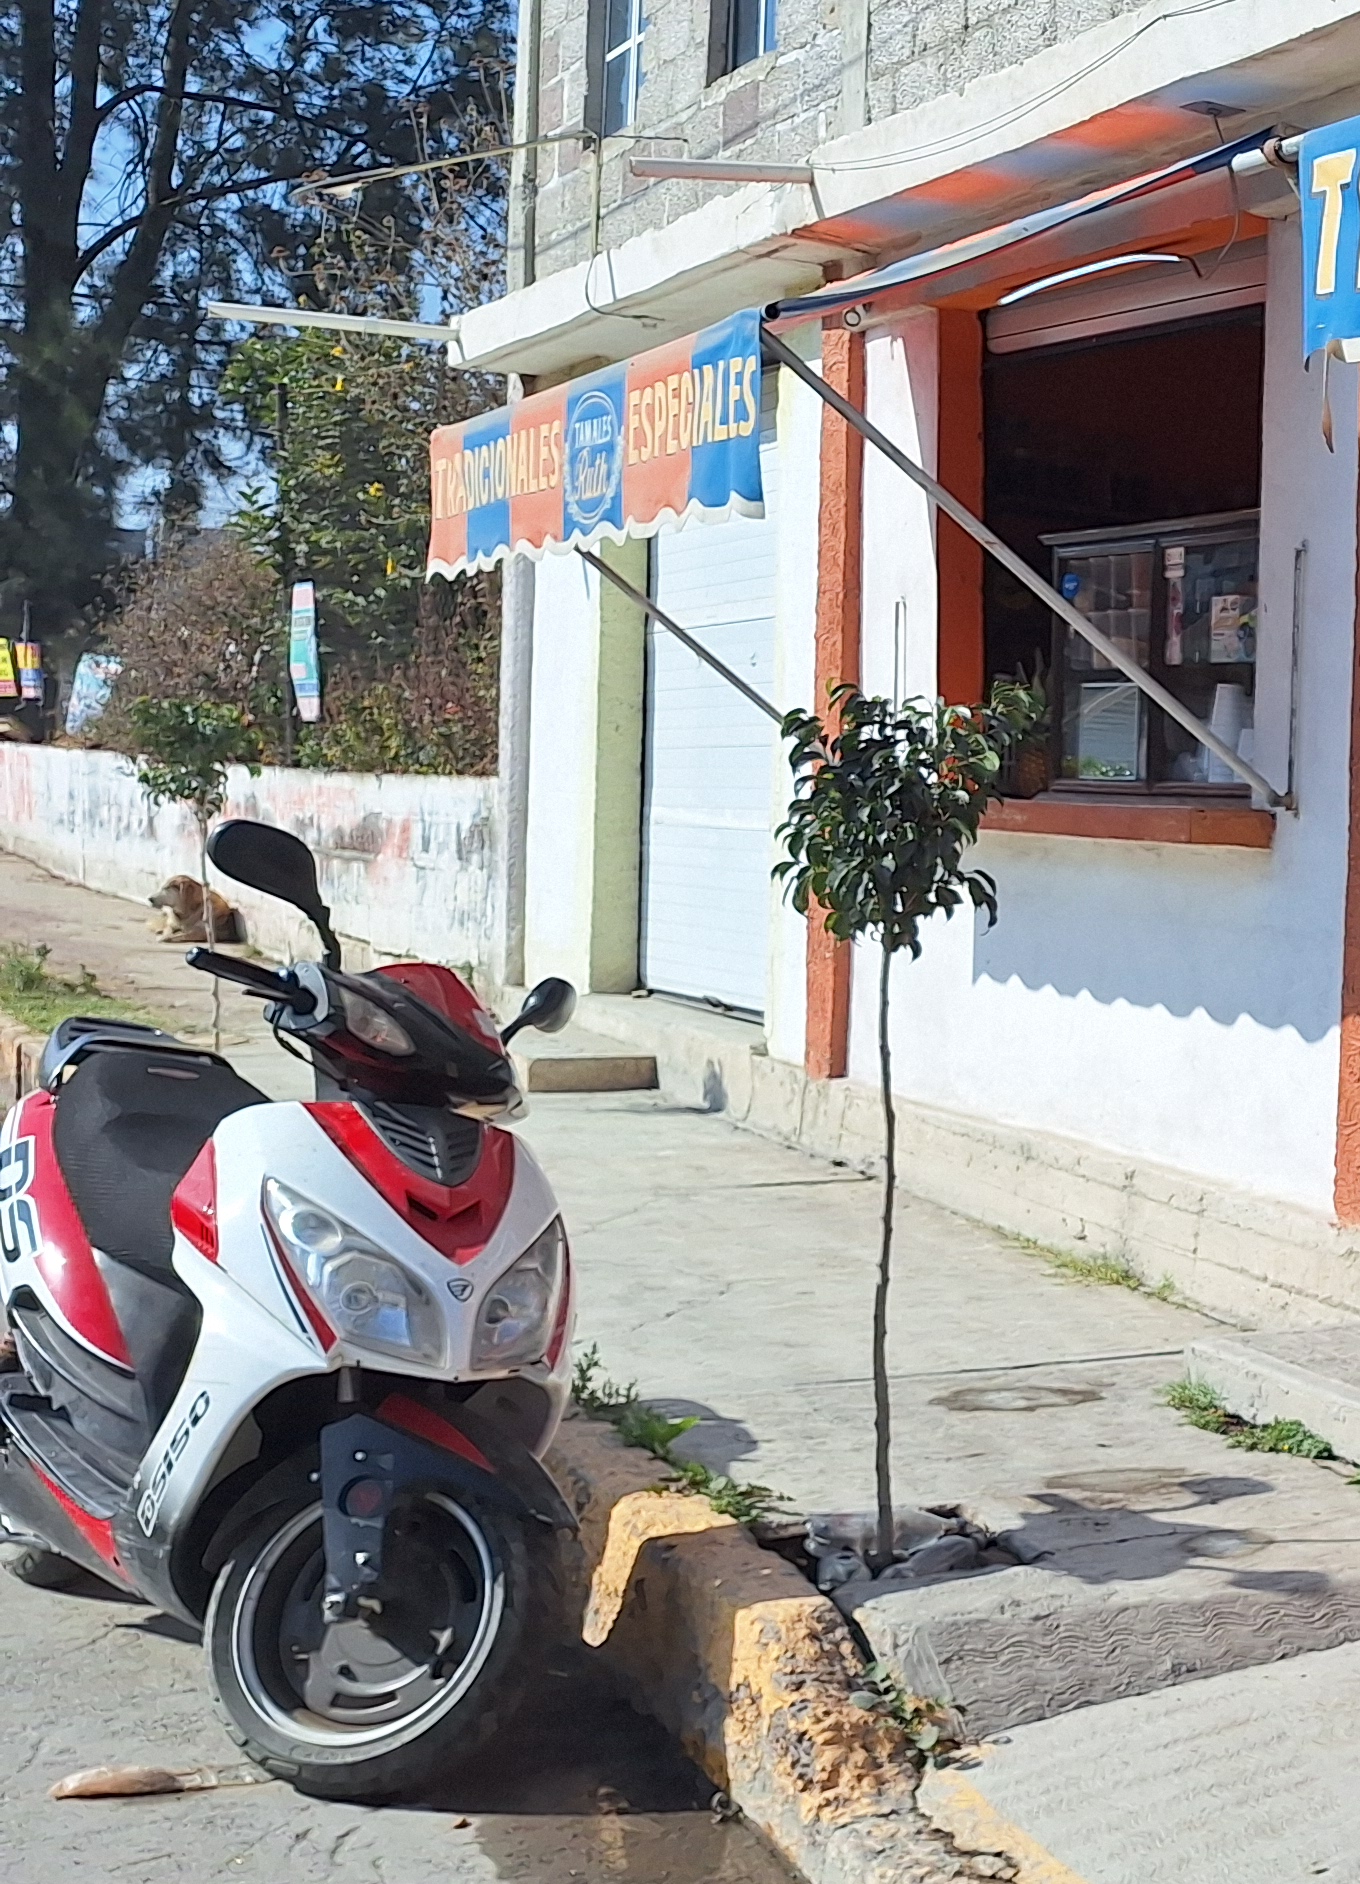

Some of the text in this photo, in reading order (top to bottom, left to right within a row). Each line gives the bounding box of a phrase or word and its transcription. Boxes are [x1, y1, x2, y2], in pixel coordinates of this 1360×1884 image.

[574, 414, 613, 449] TAMALES
[628, 355, 757, 466] ESPECIALES
[434, 419, 562, 520] TRADICIONALES
